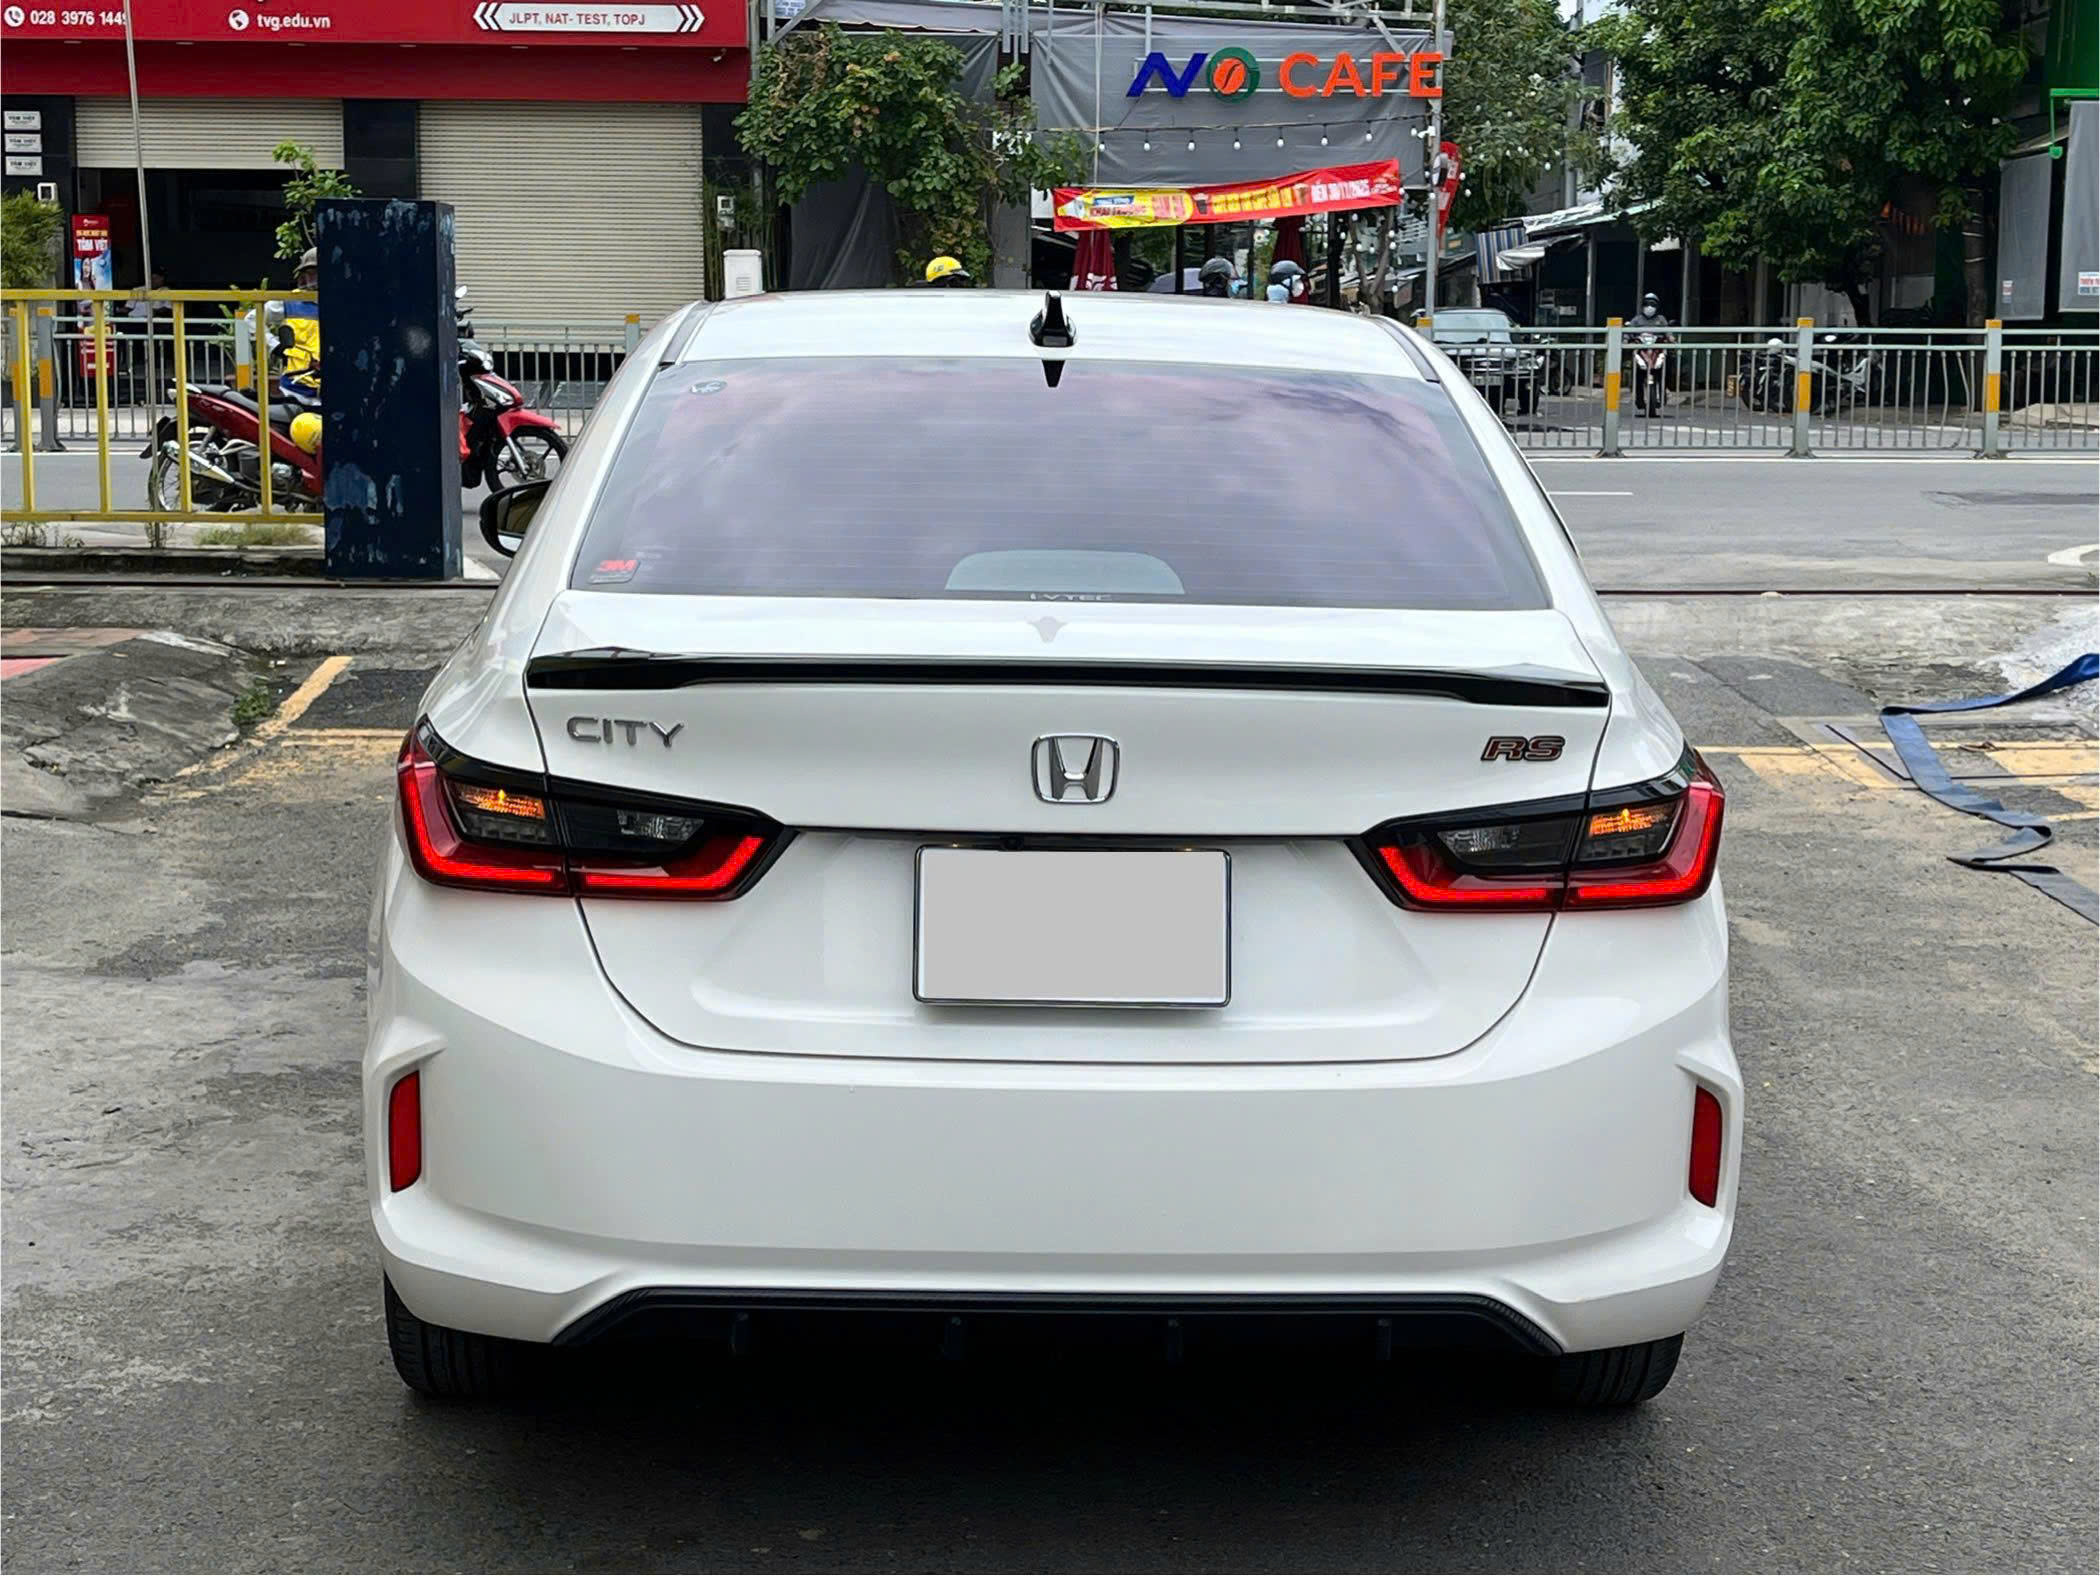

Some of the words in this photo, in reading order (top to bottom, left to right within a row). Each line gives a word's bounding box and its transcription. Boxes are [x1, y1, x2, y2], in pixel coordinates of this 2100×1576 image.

[30, 9, 56, 25] 028
[61, 10, 95, 26] 3976
[257, 12, 331, 32] tvg.edu.vn
[508, 12, 542, 25] JLPT,
[545, 12, 574, 25] NAT-
[576, 12, 611, 26] TEST,
[614, 13, 646, 26] TOPJ
[1279, 51, 1443, 99] CAFE
[566, 716, 685, 748] CITY
[1480, 735, 1566, 762] RS
